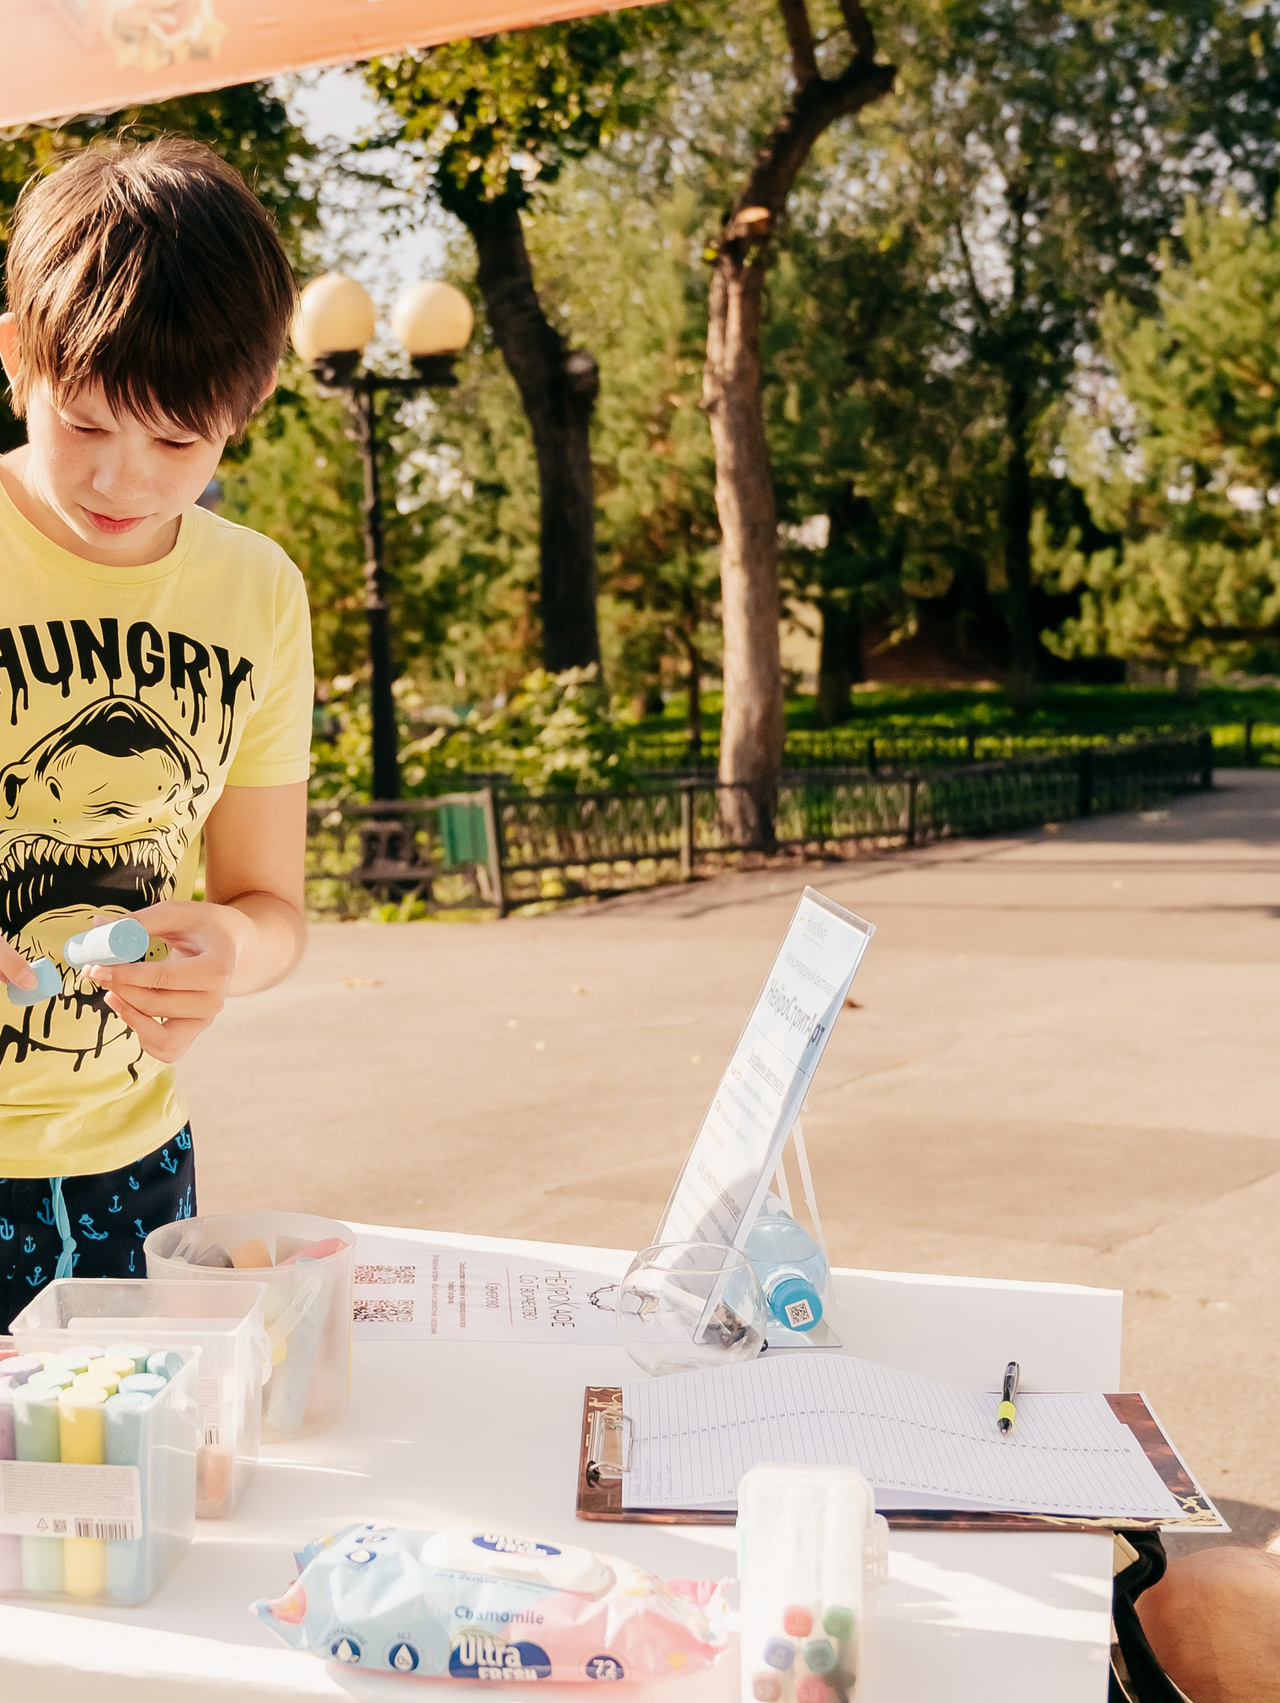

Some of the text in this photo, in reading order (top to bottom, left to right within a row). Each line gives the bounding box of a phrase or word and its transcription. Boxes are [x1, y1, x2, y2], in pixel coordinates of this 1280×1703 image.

[765, 978, 825, 1048] НейроСтритАрт
[454, 1604, 545, 1626] Chamomile
[459, 1632, 522, 1668] Ultra
[478, 1666, 539, 1681] FRESH
[592, 1658, 617, 1676] 72
